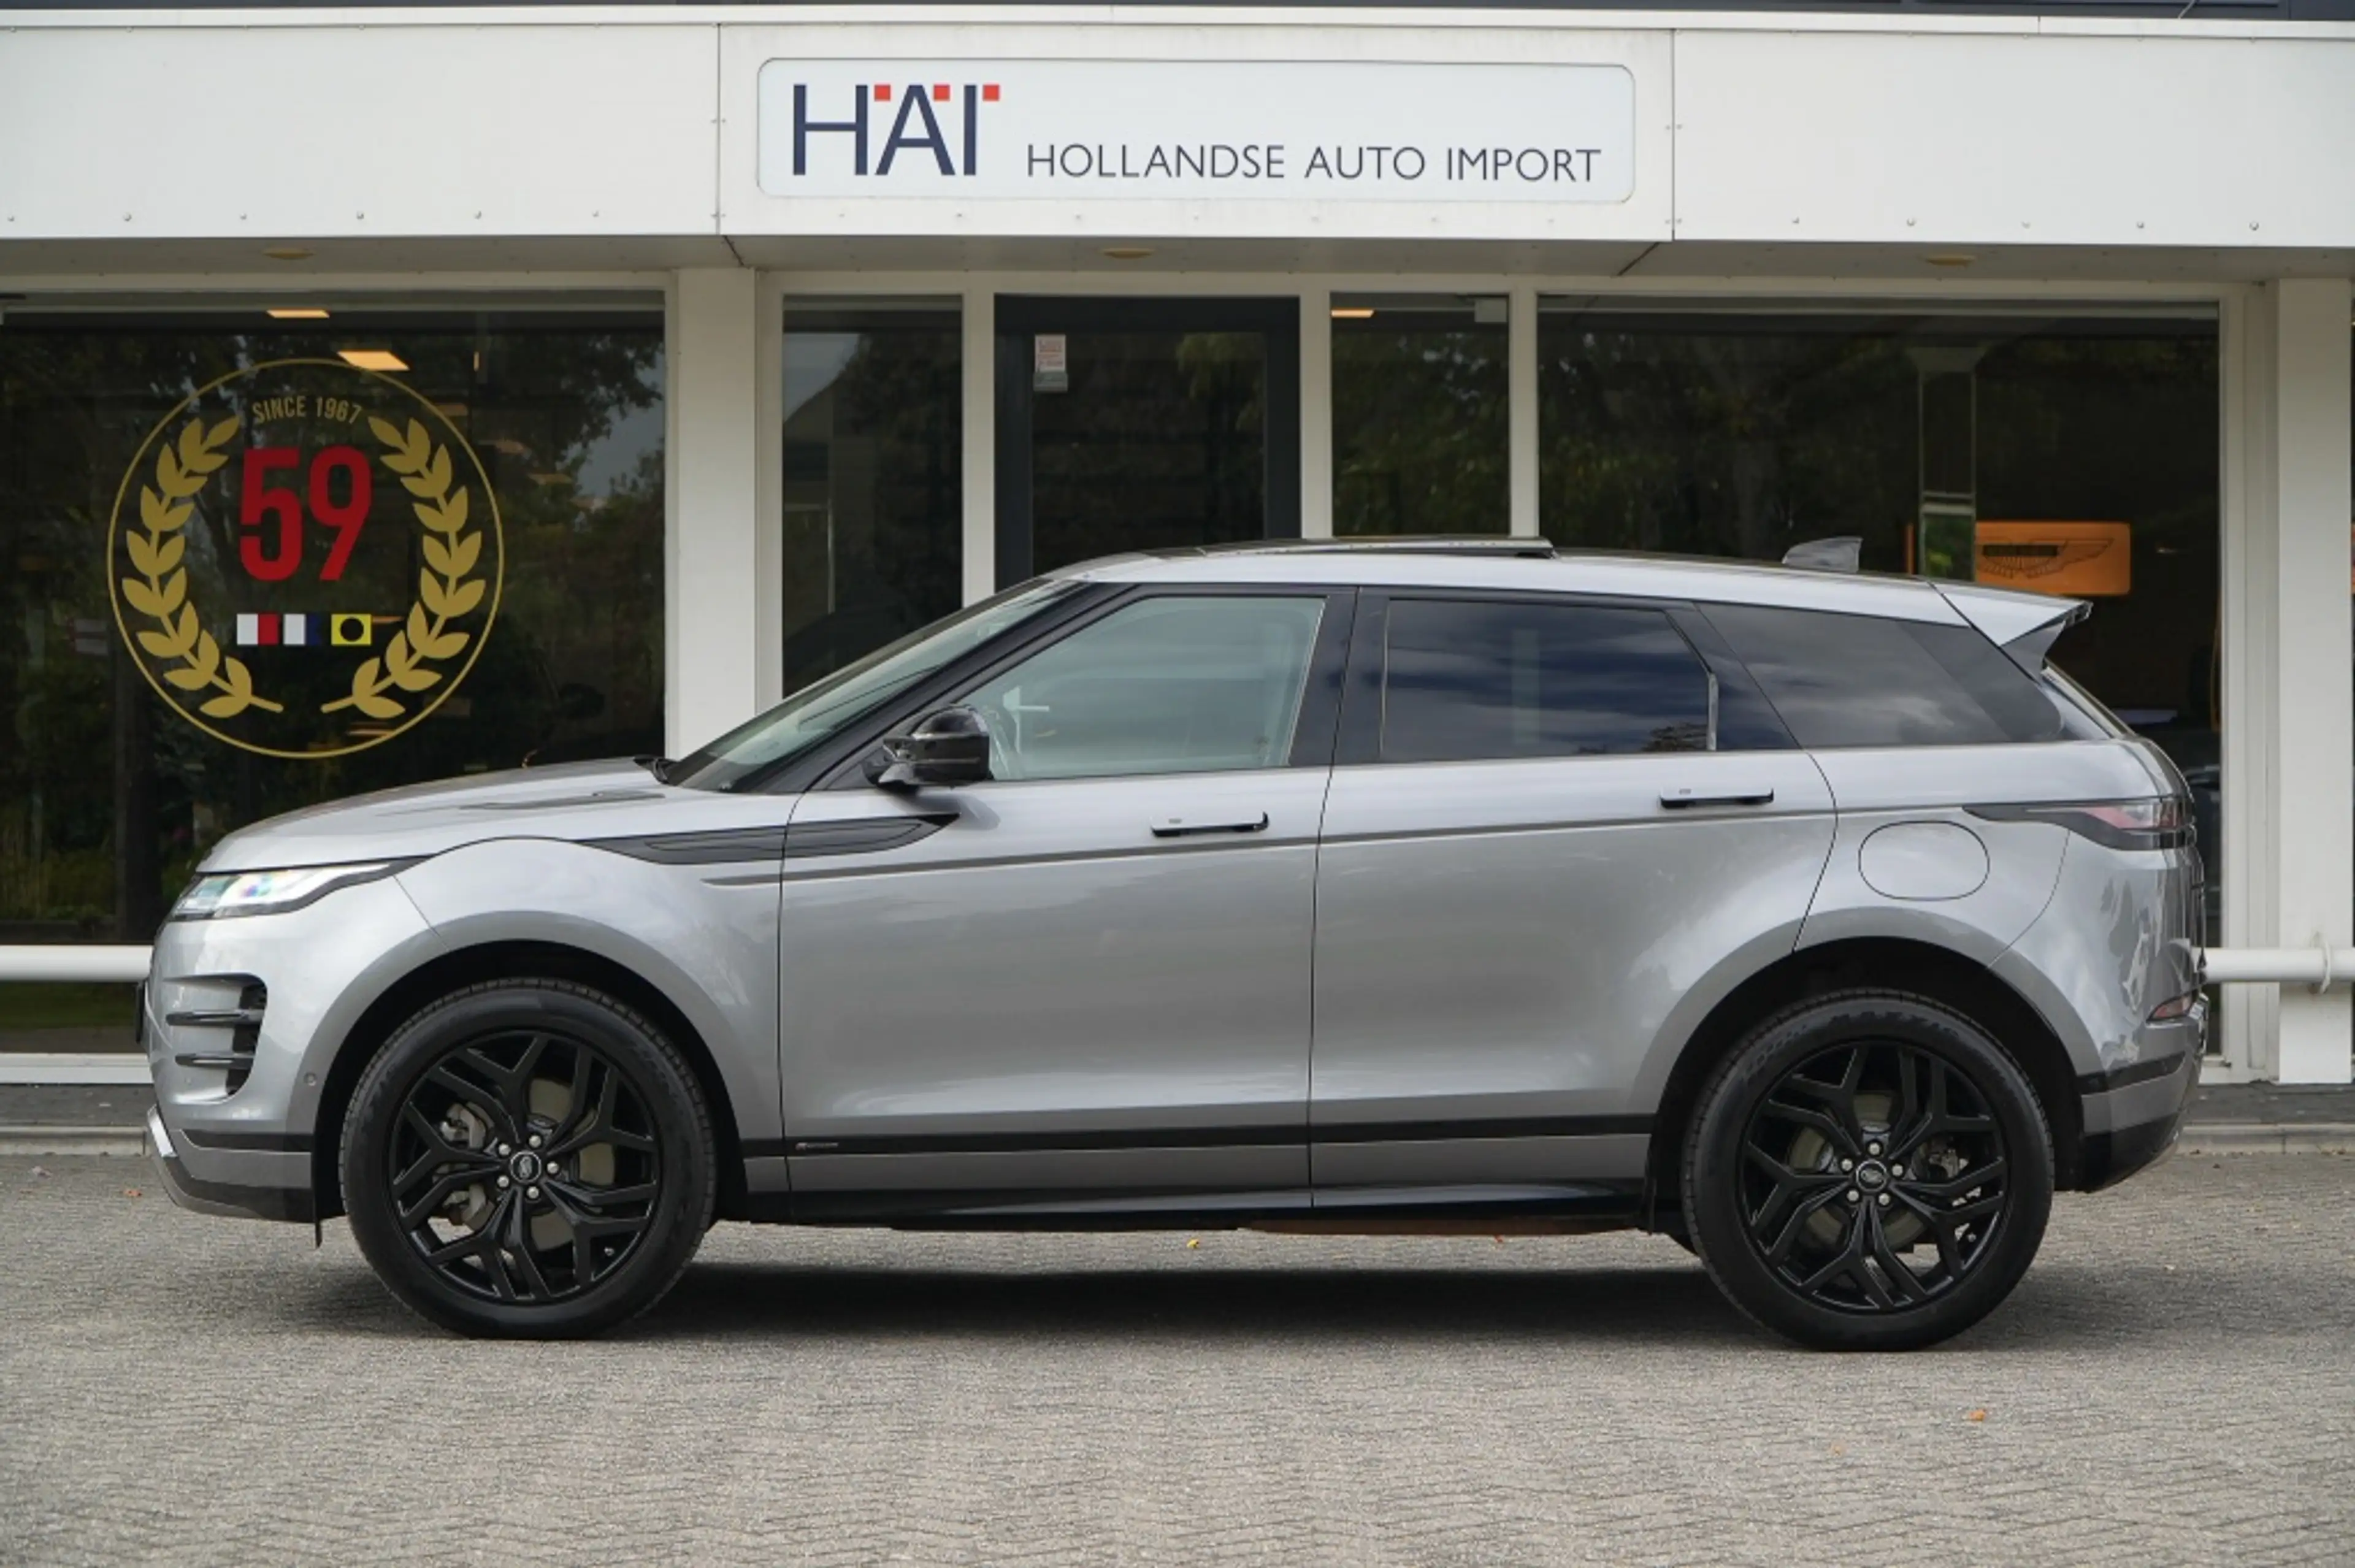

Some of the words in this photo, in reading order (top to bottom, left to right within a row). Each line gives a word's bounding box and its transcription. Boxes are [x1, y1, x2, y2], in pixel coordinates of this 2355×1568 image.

[1028, 144, 1284, 178] HOLLANDSE
[1304, 147, 1425, 180] AUTO
[1447, 148, 1601, 182] IMPORT
[252, 396, 307, 424] SINCE
[315, 397, 362, 424] 1967
[240, 445, 372, 582] 59
